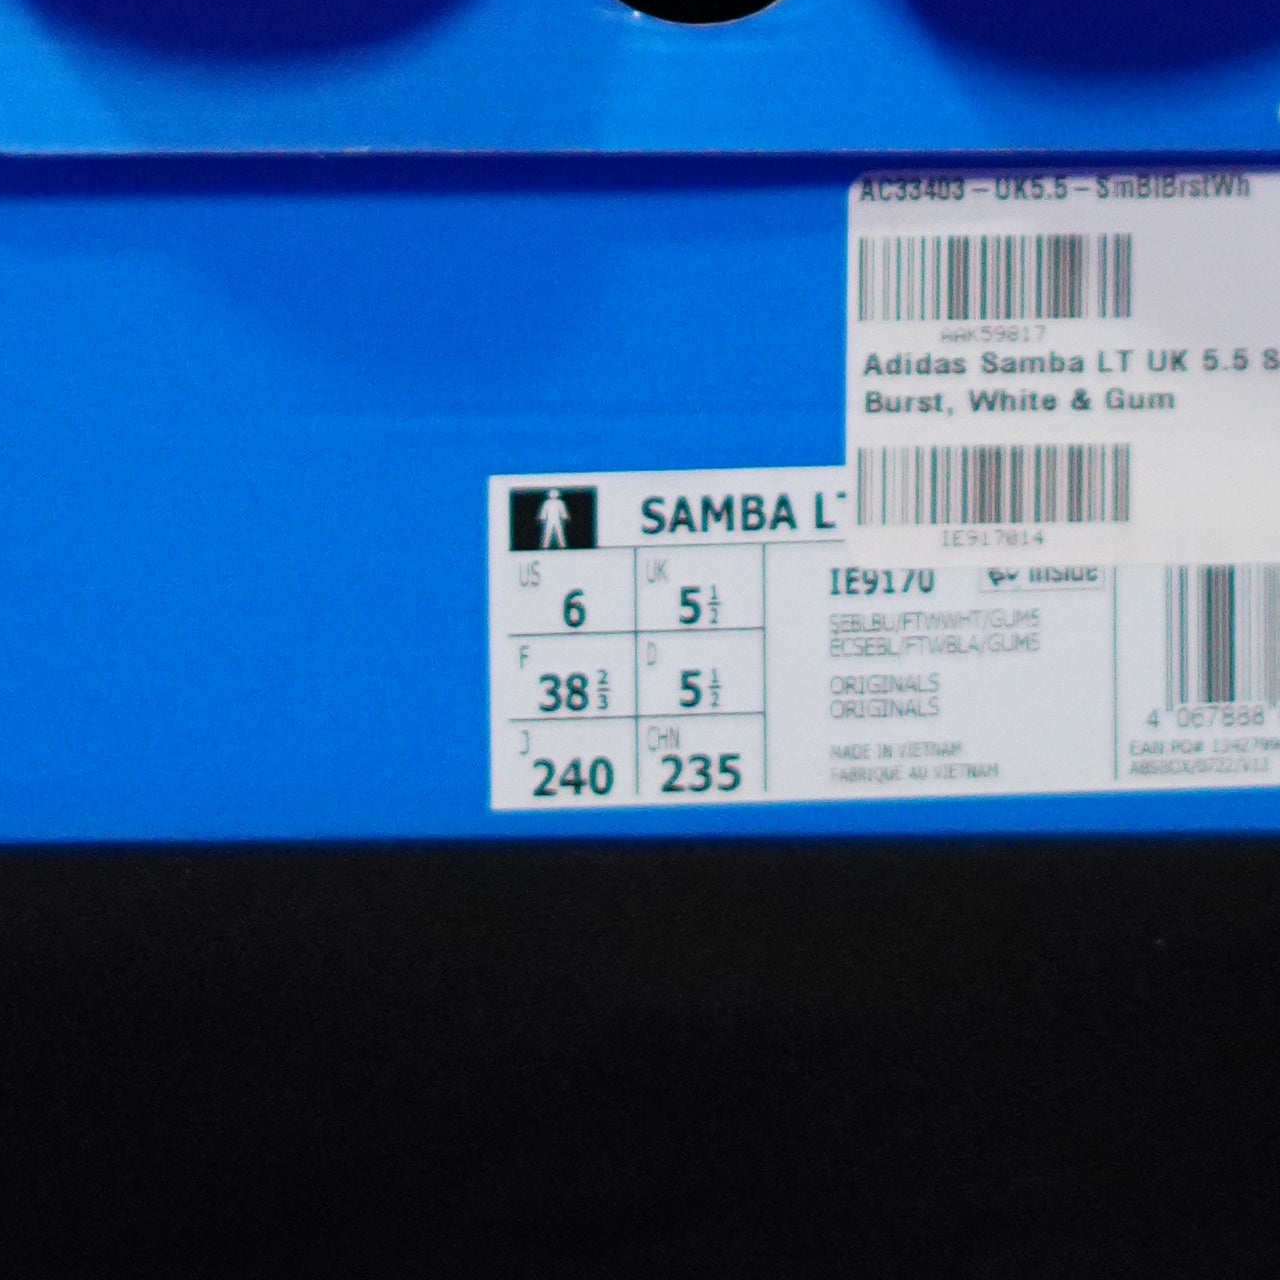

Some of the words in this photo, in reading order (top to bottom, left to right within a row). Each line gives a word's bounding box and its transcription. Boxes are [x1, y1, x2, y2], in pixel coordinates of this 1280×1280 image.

[863, 351, 968, 377] Adidas
[980, 350, 1086, 375] Samba
[1096, 348, 1134, 374] LT
[1146, 347, 1189, 373] UK
[1202, 347, 1250, 372] 5.5
[864, 390, 955, 418] Burst,
[968, 388, 1058, 414] White
[1070, 388, 1092, 412] &
[1104, 386, 1176, 412] Gum
[640, 491, 799, 536] SAMBA
[814, 490, 847, 530] L
[517, 559, 542, 587] US
[643, 558, 668, 584] UK
[830, 566, 936, 596] IE9170
[562, 589, 587, 628] 6
[830, 672, 942, 695] ORIGINALS
[830, 696, 942, 719] ORIGINALS
[1144, 707, 1161, 729] 4
[646, 726, 681, 752] CHN
[532, 756, 615, 797] 240
[660, 753, 742, 793] 235
